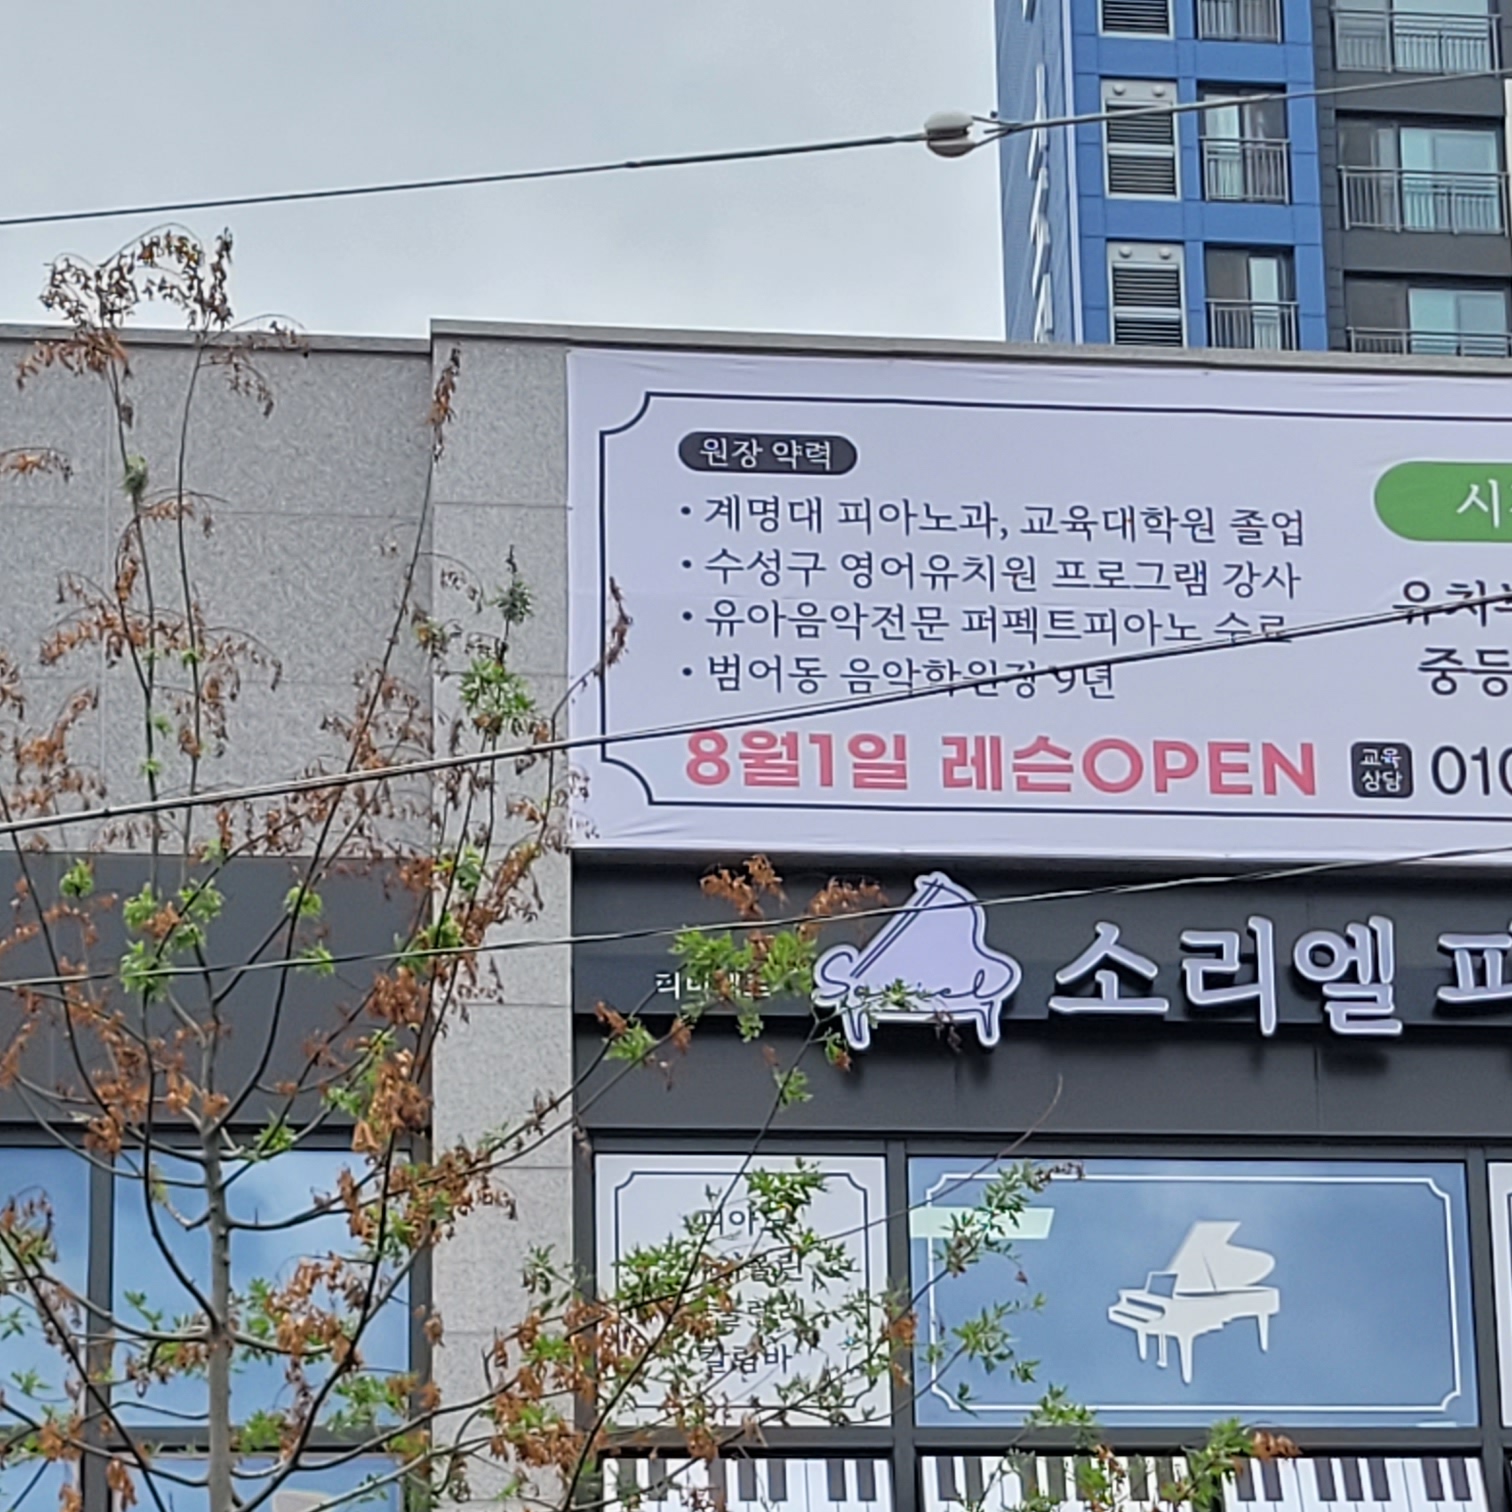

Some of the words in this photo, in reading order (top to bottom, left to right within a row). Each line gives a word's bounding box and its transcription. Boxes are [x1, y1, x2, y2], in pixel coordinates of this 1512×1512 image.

[699, 438, 763, 471] 원장
[771, 439, 833, 472] 약력
[705, 494, 823, 534] 계명대
[837, 497, 1009, 541] 피아노과,
[1020, 503, 1217, 546] 교육대학원
[1229, 507, 1305, 548] 졸업
[705, 546, 828, 586] 수성구
[839, 551, 1039, 593] 영어유치원
[1051, 558, 1207, 598] 프로그램
[1222, 560, 1302, 601] 강사
[706, 599, 951, 640] 유아음악전문
[960, 605, 1203, 647] 퍼펙트피아노
[708, 652, 828, 695] 범어동
[839, 657, 1036, 700] 음악학원장
[1052, 660, 1116, 700] 9년
[685, 730, 909, 790] 8월1일
[941, 734, 1317, 797] 레슨OPEN
[1049, 916, 1403, 1038] 소리엘
